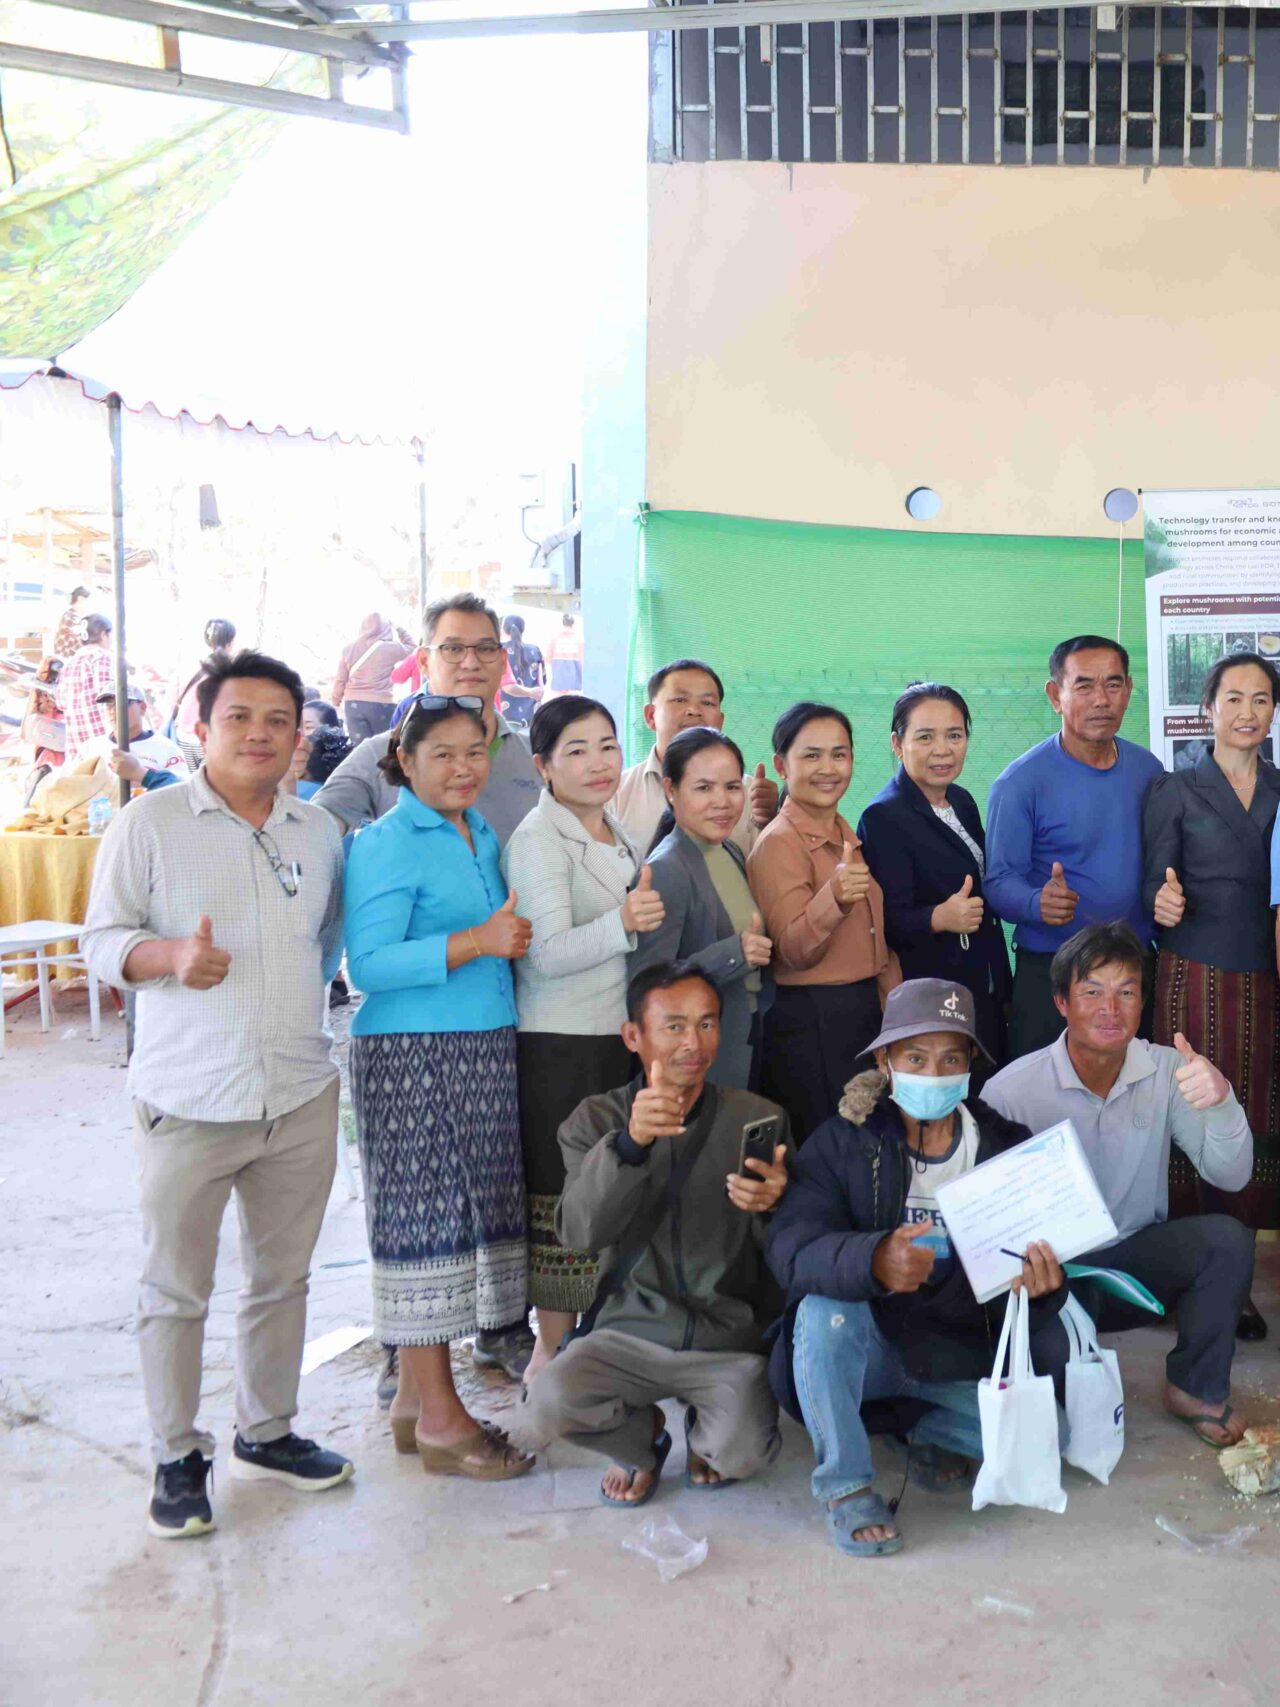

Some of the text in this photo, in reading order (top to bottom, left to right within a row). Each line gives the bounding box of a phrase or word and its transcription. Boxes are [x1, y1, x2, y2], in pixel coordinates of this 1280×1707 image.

[1159, 517, 1210, 525] Technology
[1165, 528, 1218, 536] mushrooms
[1219, 527, 1232, 535] for
[1234, 526, 1277, 535] economic
[1167, 539, 1225, 548] development
[1228, 540, 1258, 548] among
[1163, 597, 1191, 605] Explore
[1192, 596, 1235, 604] mushrooms
[1182, 606, 1211, 615] country
